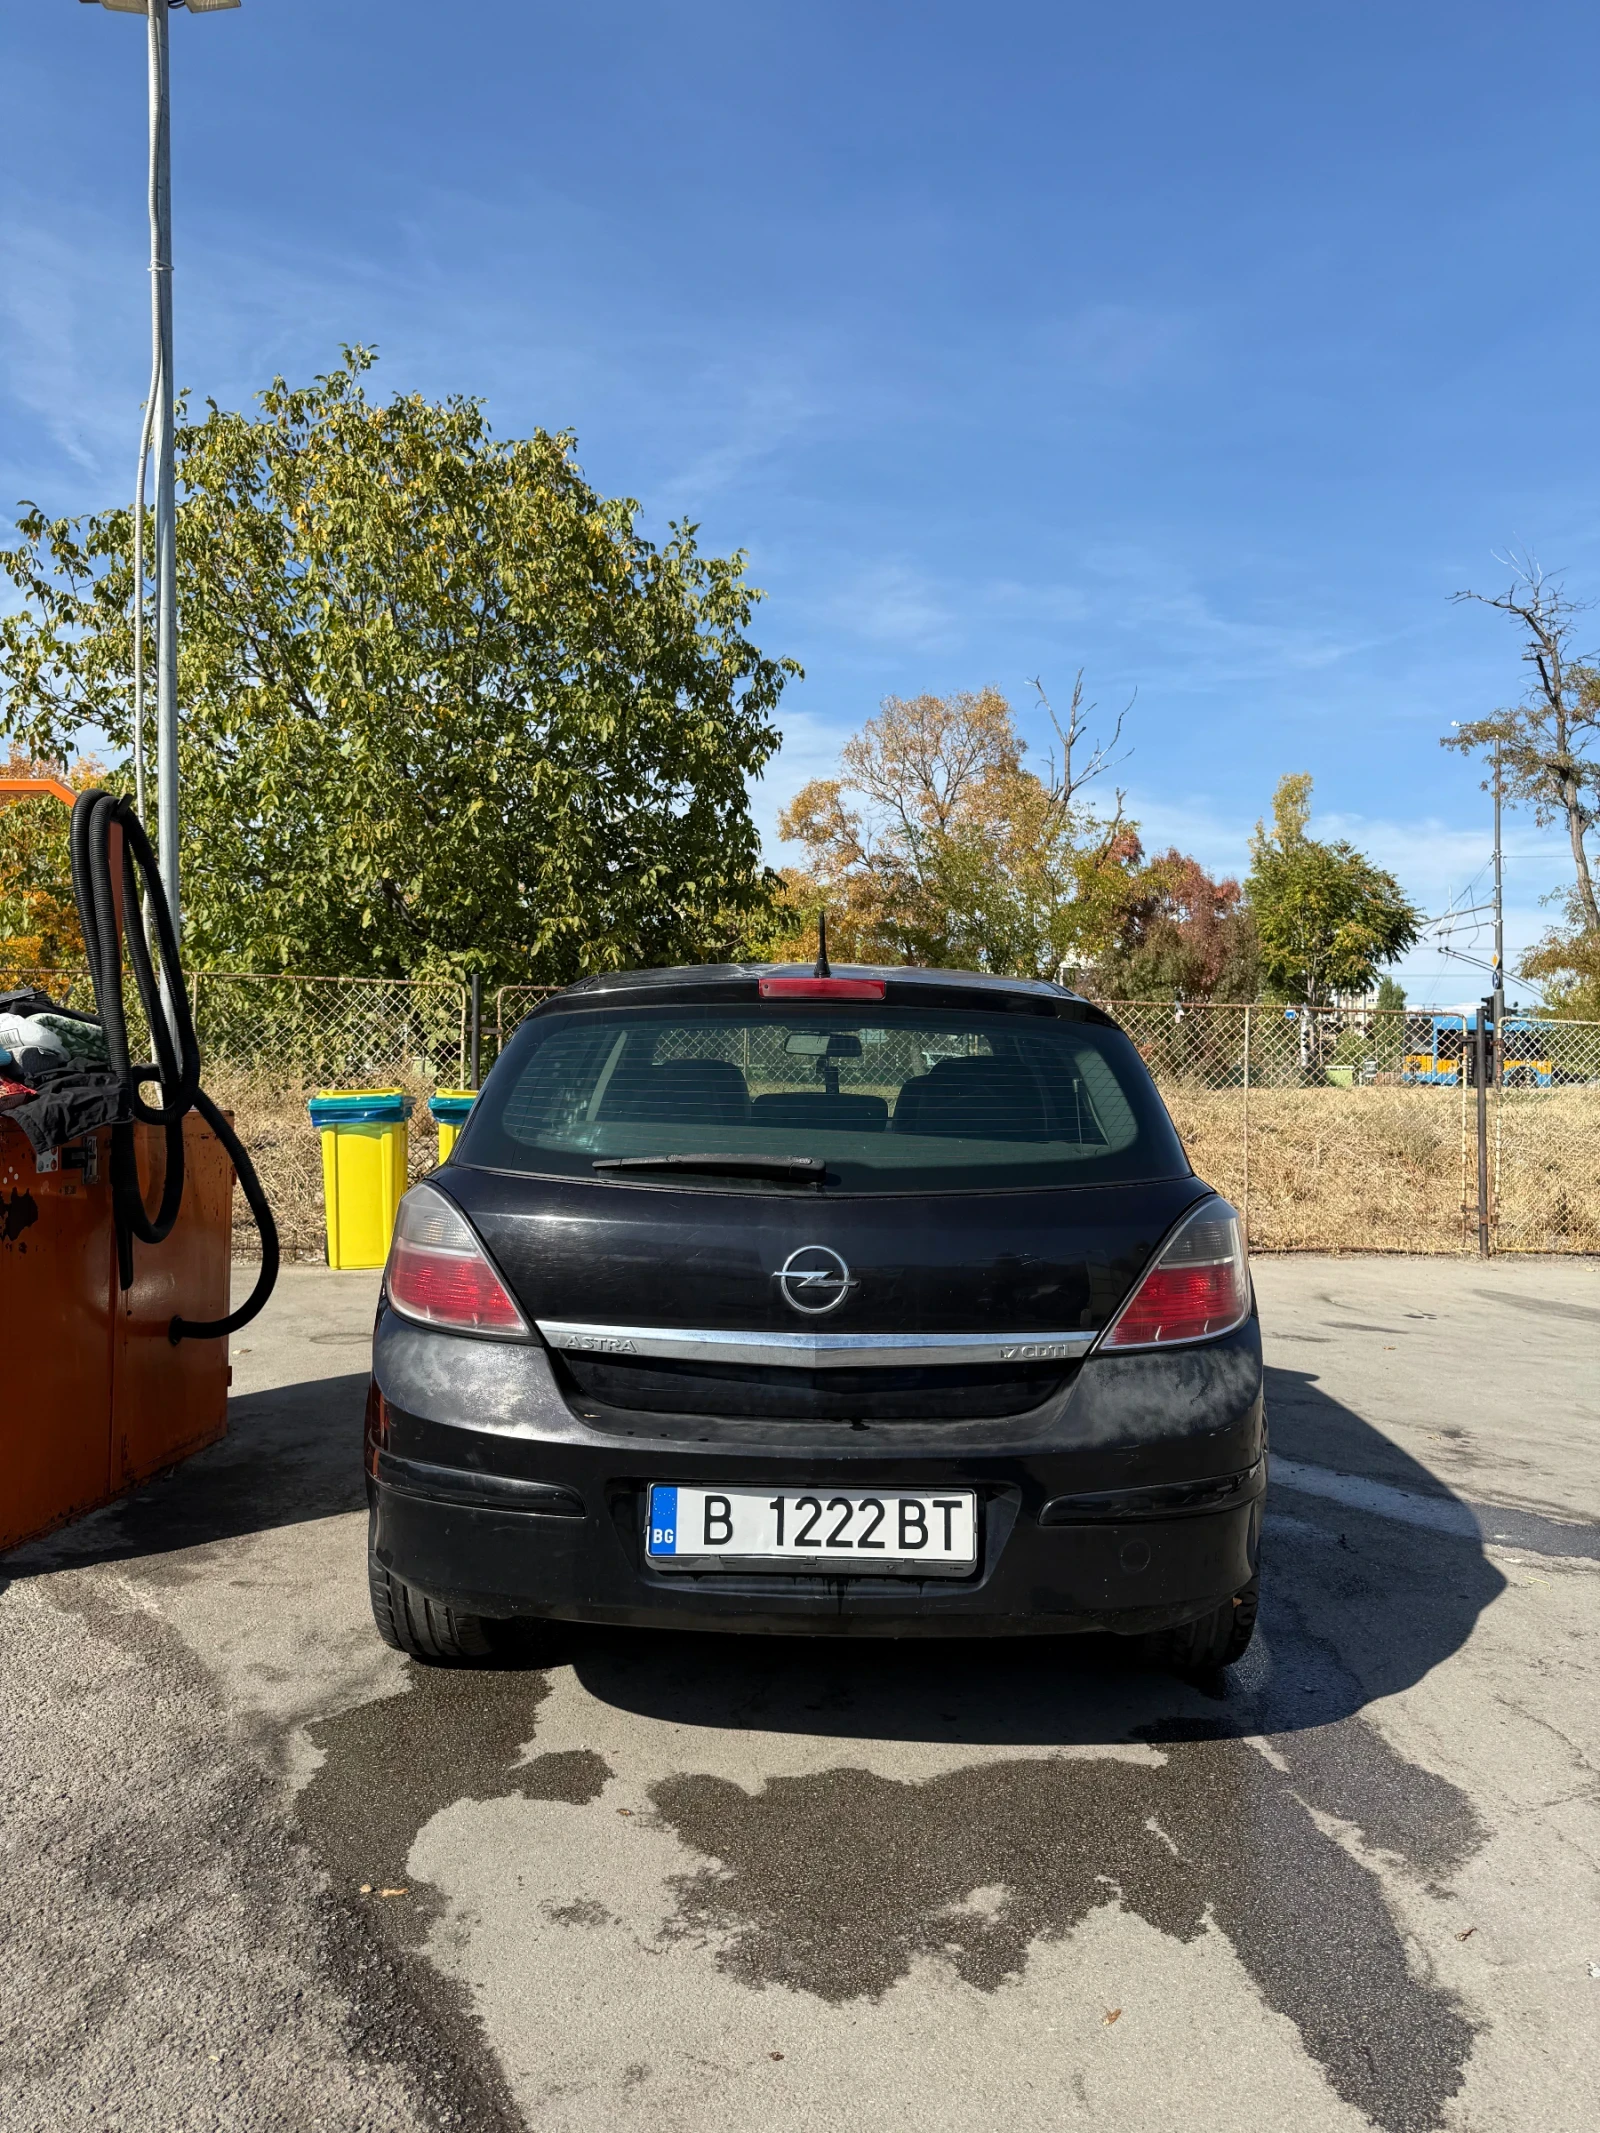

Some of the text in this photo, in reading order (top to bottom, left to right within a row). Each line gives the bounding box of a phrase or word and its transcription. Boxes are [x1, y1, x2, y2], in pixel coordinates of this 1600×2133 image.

[564, 1336, 637, 1353] ASTRA
[703, 1495, 734, 1546] B
[652, 1528, 674, 1543] BG
